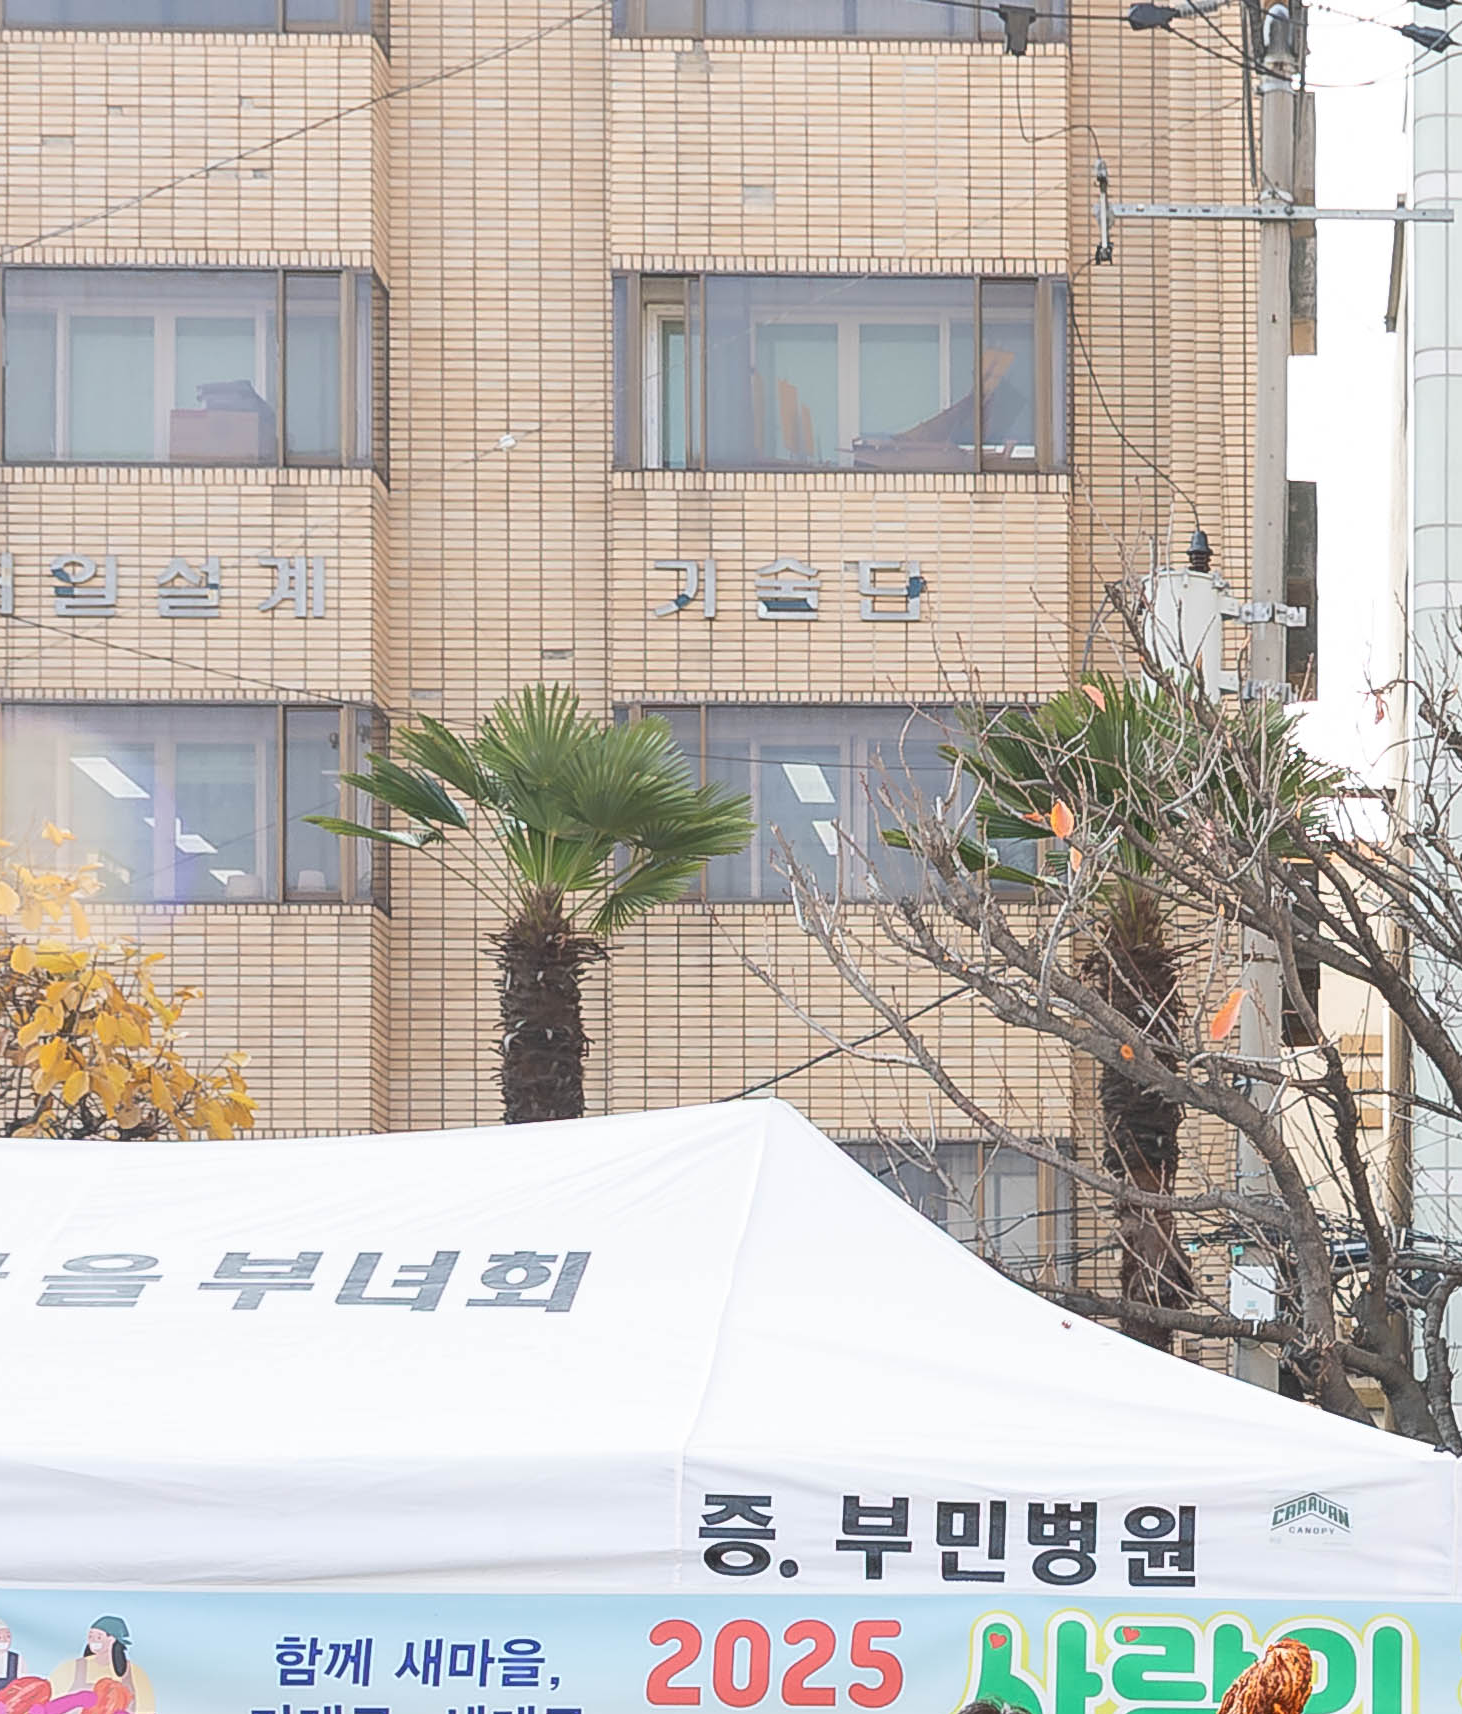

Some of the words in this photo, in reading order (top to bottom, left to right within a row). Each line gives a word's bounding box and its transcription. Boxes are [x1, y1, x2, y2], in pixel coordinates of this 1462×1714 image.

[698, 1492, 799, 1579] 증.
[834, 1494, 1198, 1588] 부민병원
[1288, 1526, 1336, 1536] CANOPY
[272, 1633, 374, 1689] 함께
[394, 1633, 562, 1691] 새마을,
[644, 1617, 904, 1710] 2025
